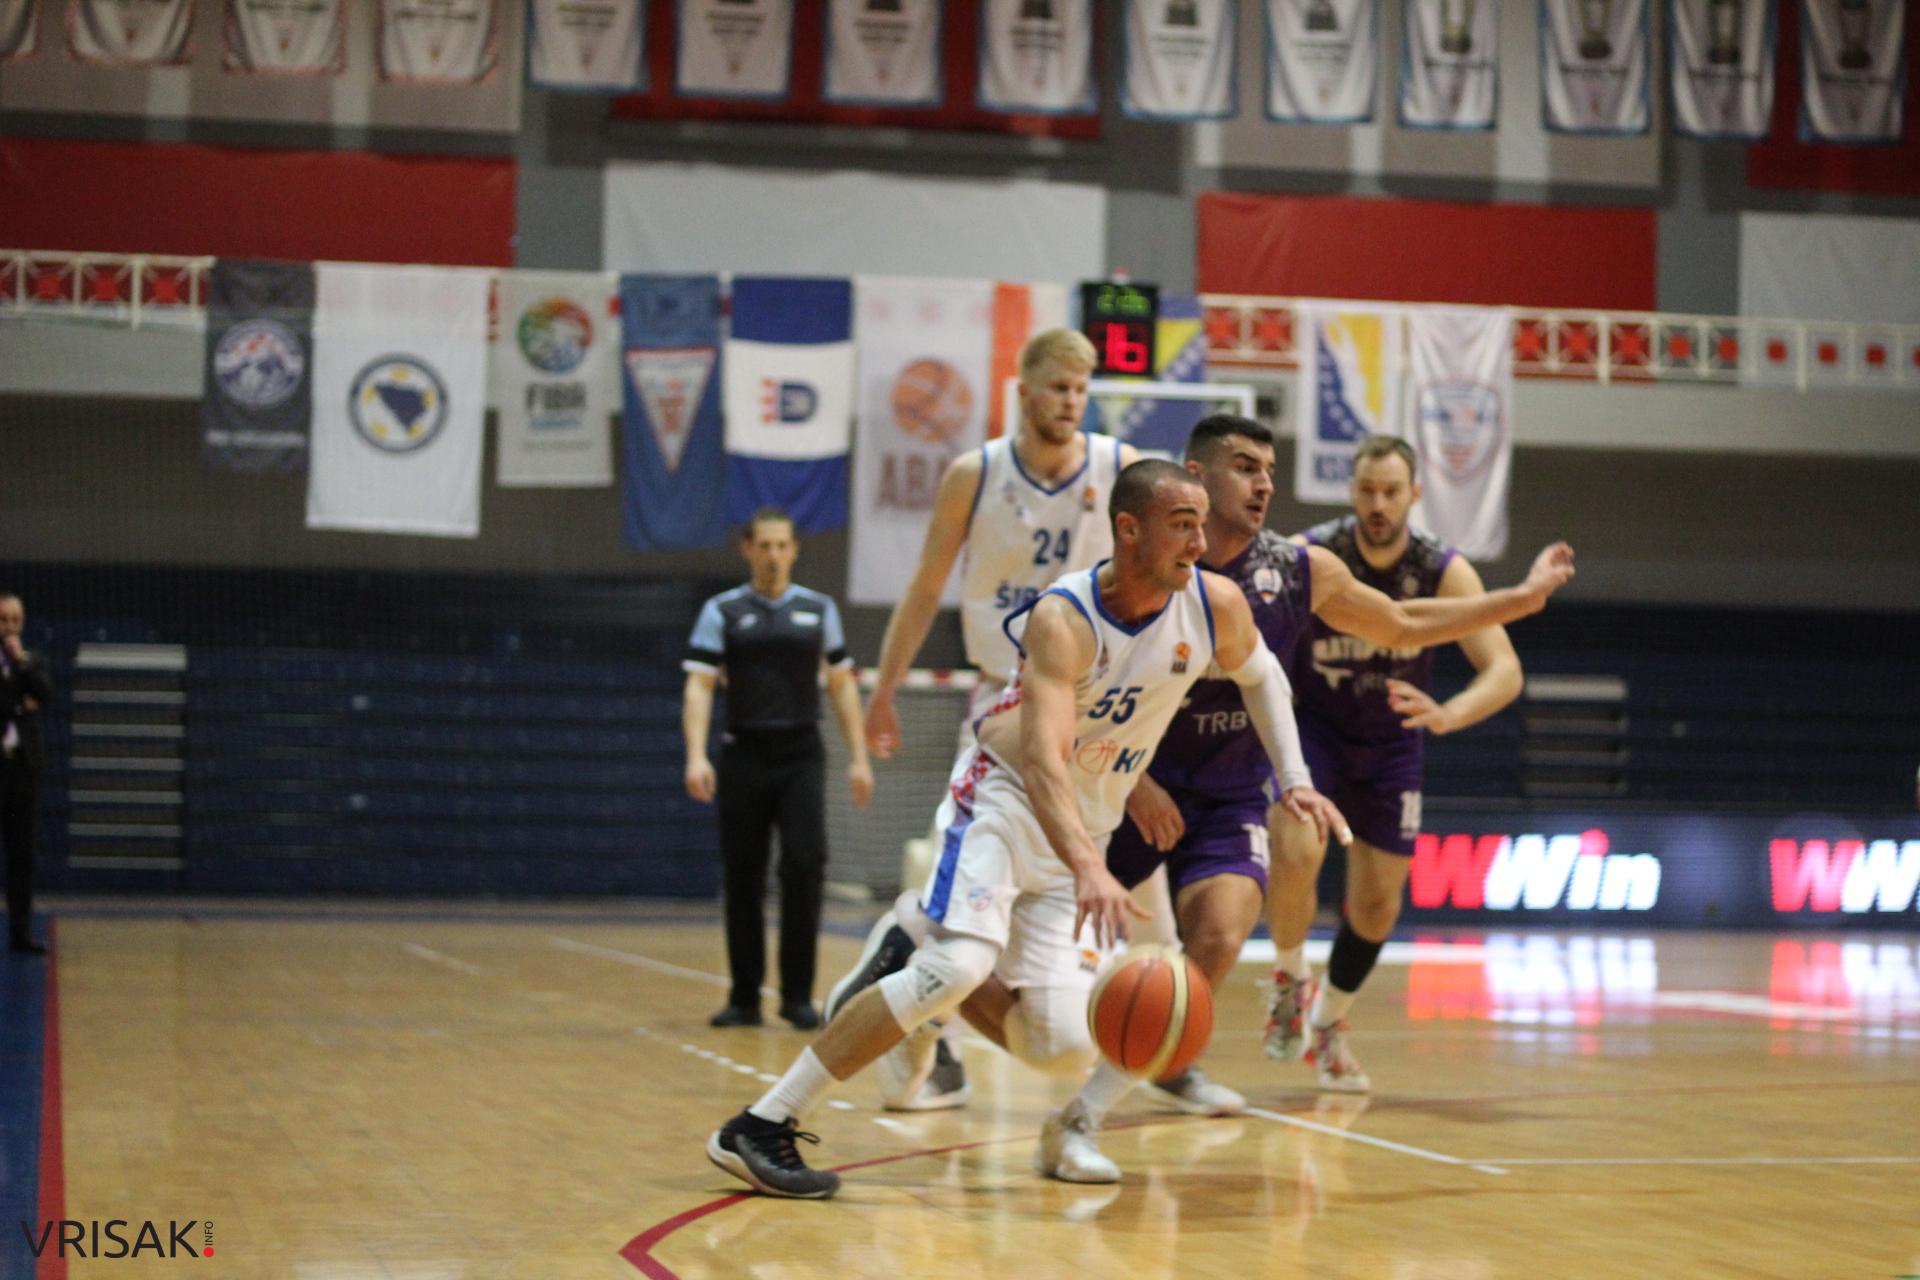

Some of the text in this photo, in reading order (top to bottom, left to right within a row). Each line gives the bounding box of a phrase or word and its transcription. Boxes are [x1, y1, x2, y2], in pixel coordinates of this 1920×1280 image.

[1033, 528, 1070, 566] 24
[1088, 686, 1144, 724] 55
[1192, 710, 1248, 735] TRB
[1410, 829, 1661, 910] WWin
[1770, 838, 1920, 912] WW
